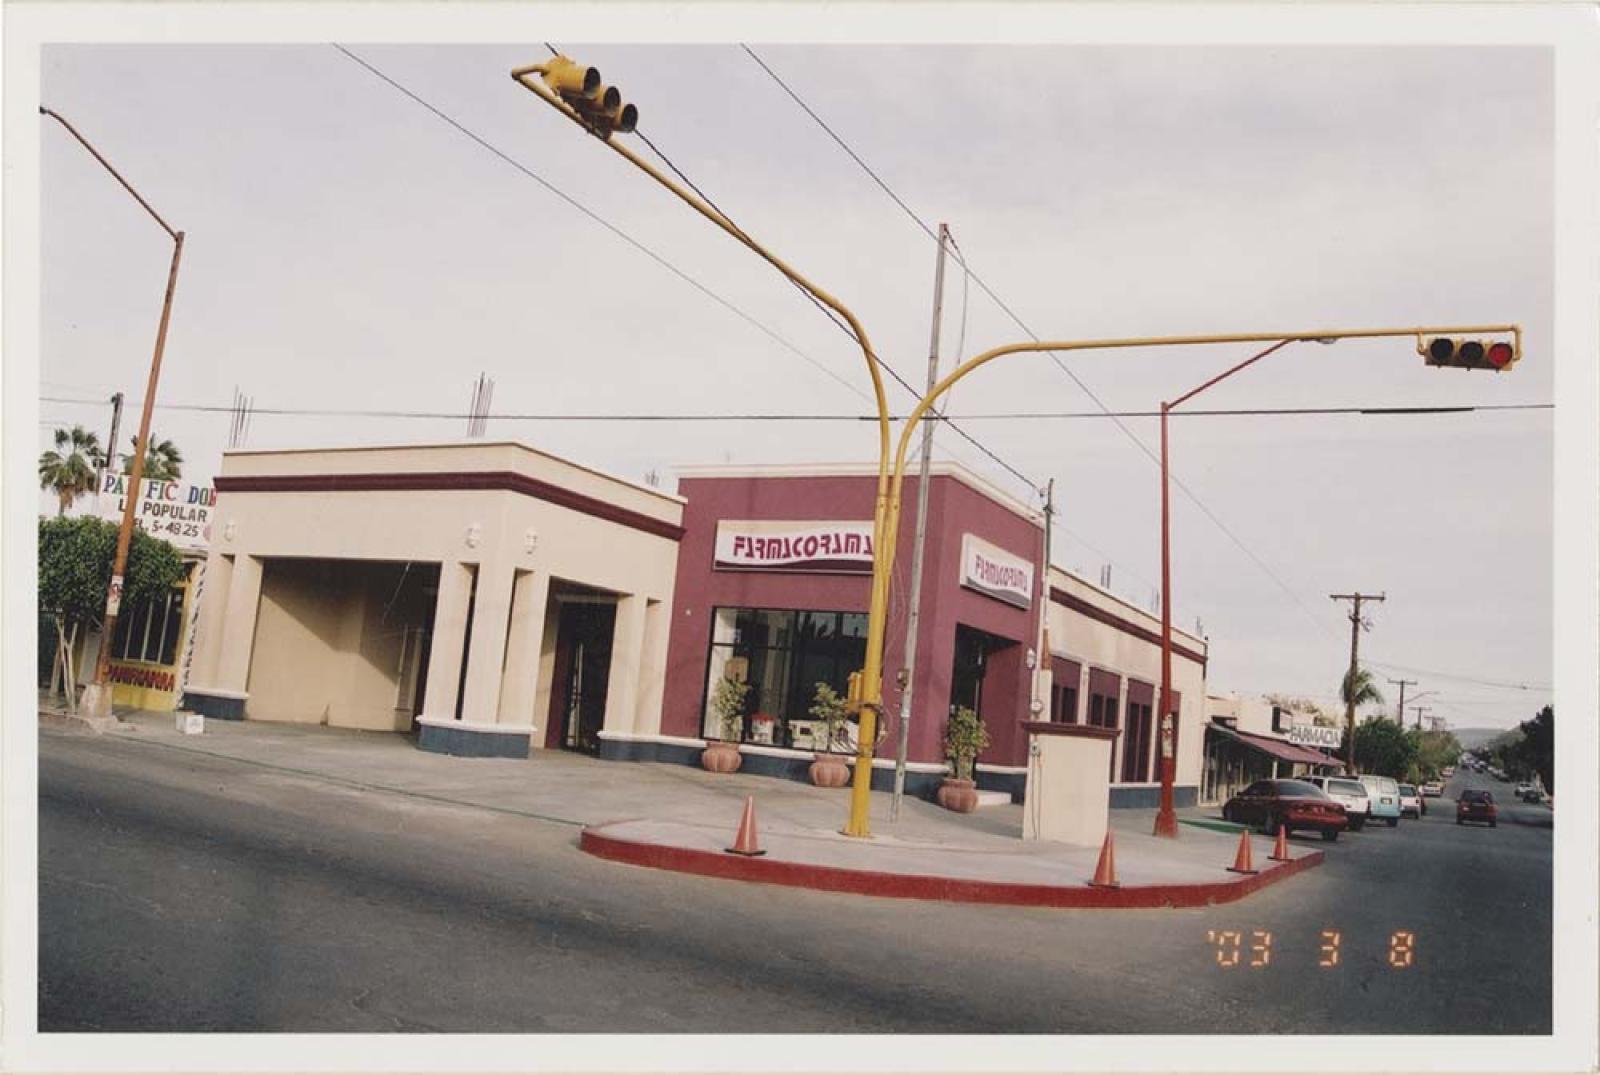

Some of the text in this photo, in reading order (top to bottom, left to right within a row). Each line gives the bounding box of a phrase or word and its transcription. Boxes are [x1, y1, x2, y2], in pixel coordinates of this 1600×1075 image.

[142, 501, 207, 522] POPULAR
[732, 532, 874, 559] FARMACORAMA
[974, 553, 1028, 592] FARMACORAMA
